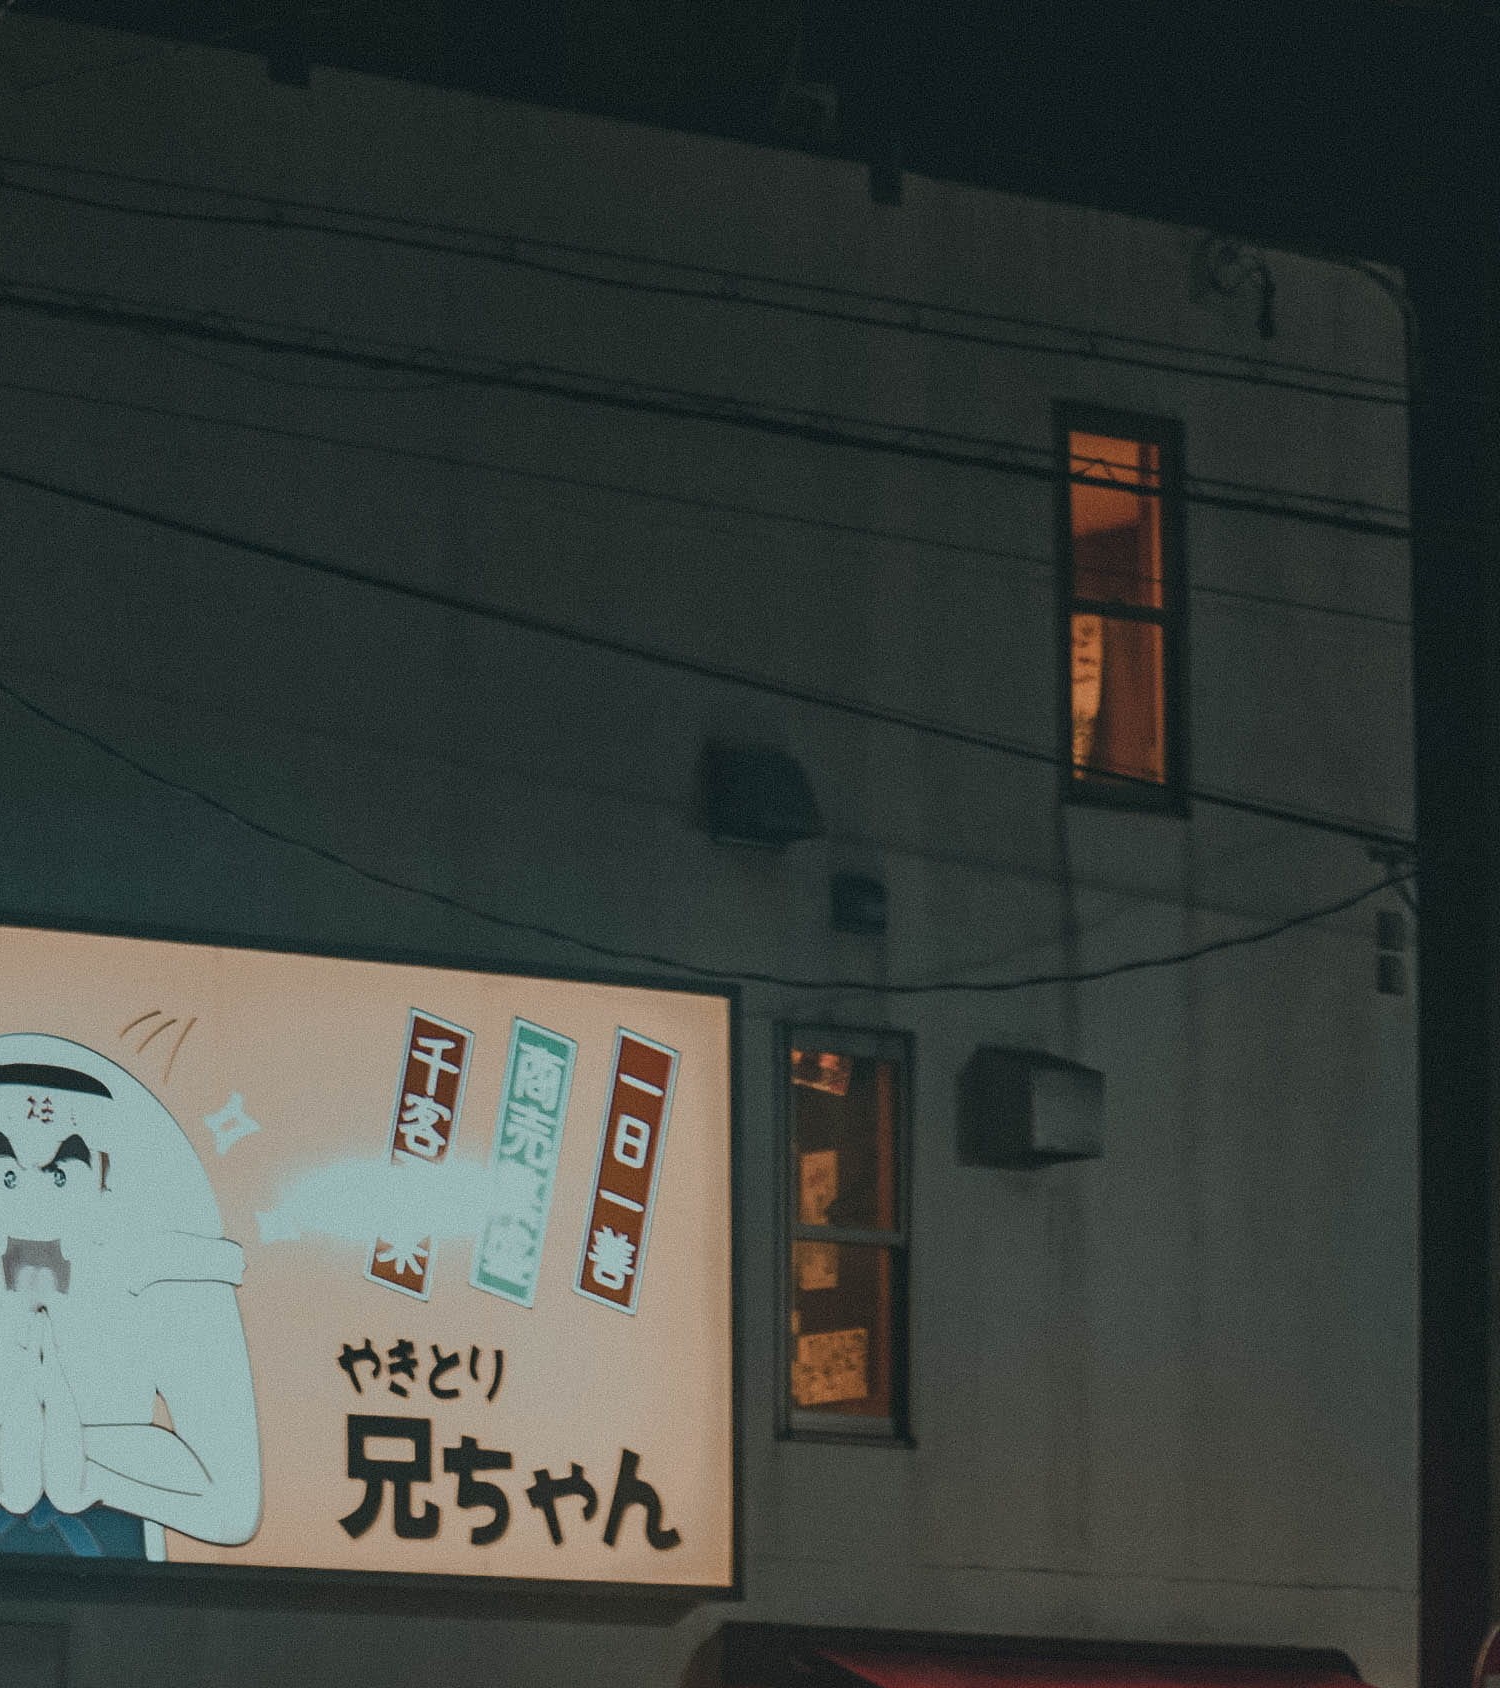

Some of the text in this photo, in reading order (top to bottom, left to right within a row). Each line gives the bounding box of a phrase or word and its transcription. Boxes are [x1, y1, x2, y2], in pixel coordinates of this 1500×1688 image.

[587, 1072, 665, 1291] 一日一善
[336, 1337, 505, 1401] やきとり
[338, 1412, 681, 1551] 兄ちゃん
